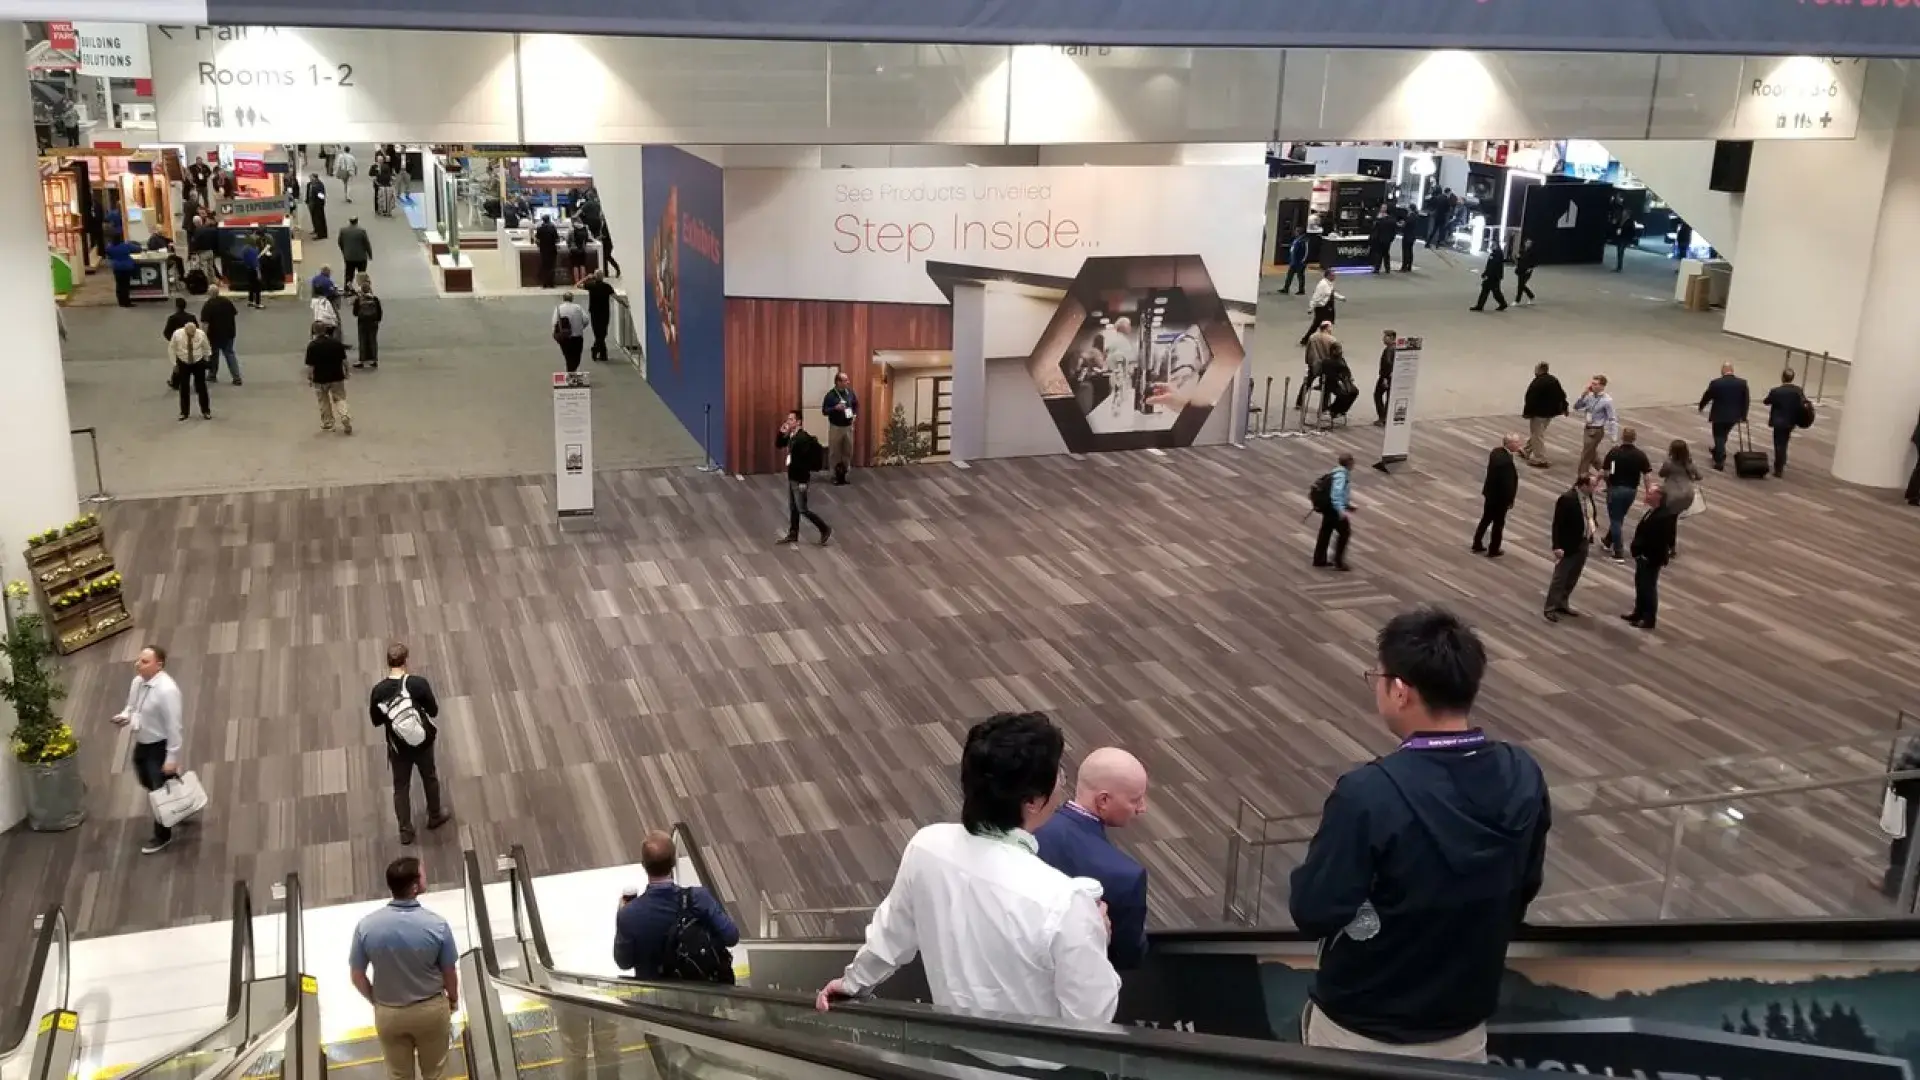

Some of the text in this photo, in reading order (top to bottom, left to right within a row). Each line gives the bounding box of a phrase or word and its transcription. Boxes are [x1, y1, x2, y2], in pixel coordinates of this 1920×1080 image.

[199, 61, 354, 87] Rooms 1-2
[834, 183, 1053, 202] See Products Unveiled
[682, 212, 721, 265] Exhibits
[833, 209, 1100, 263] Step Inside...
